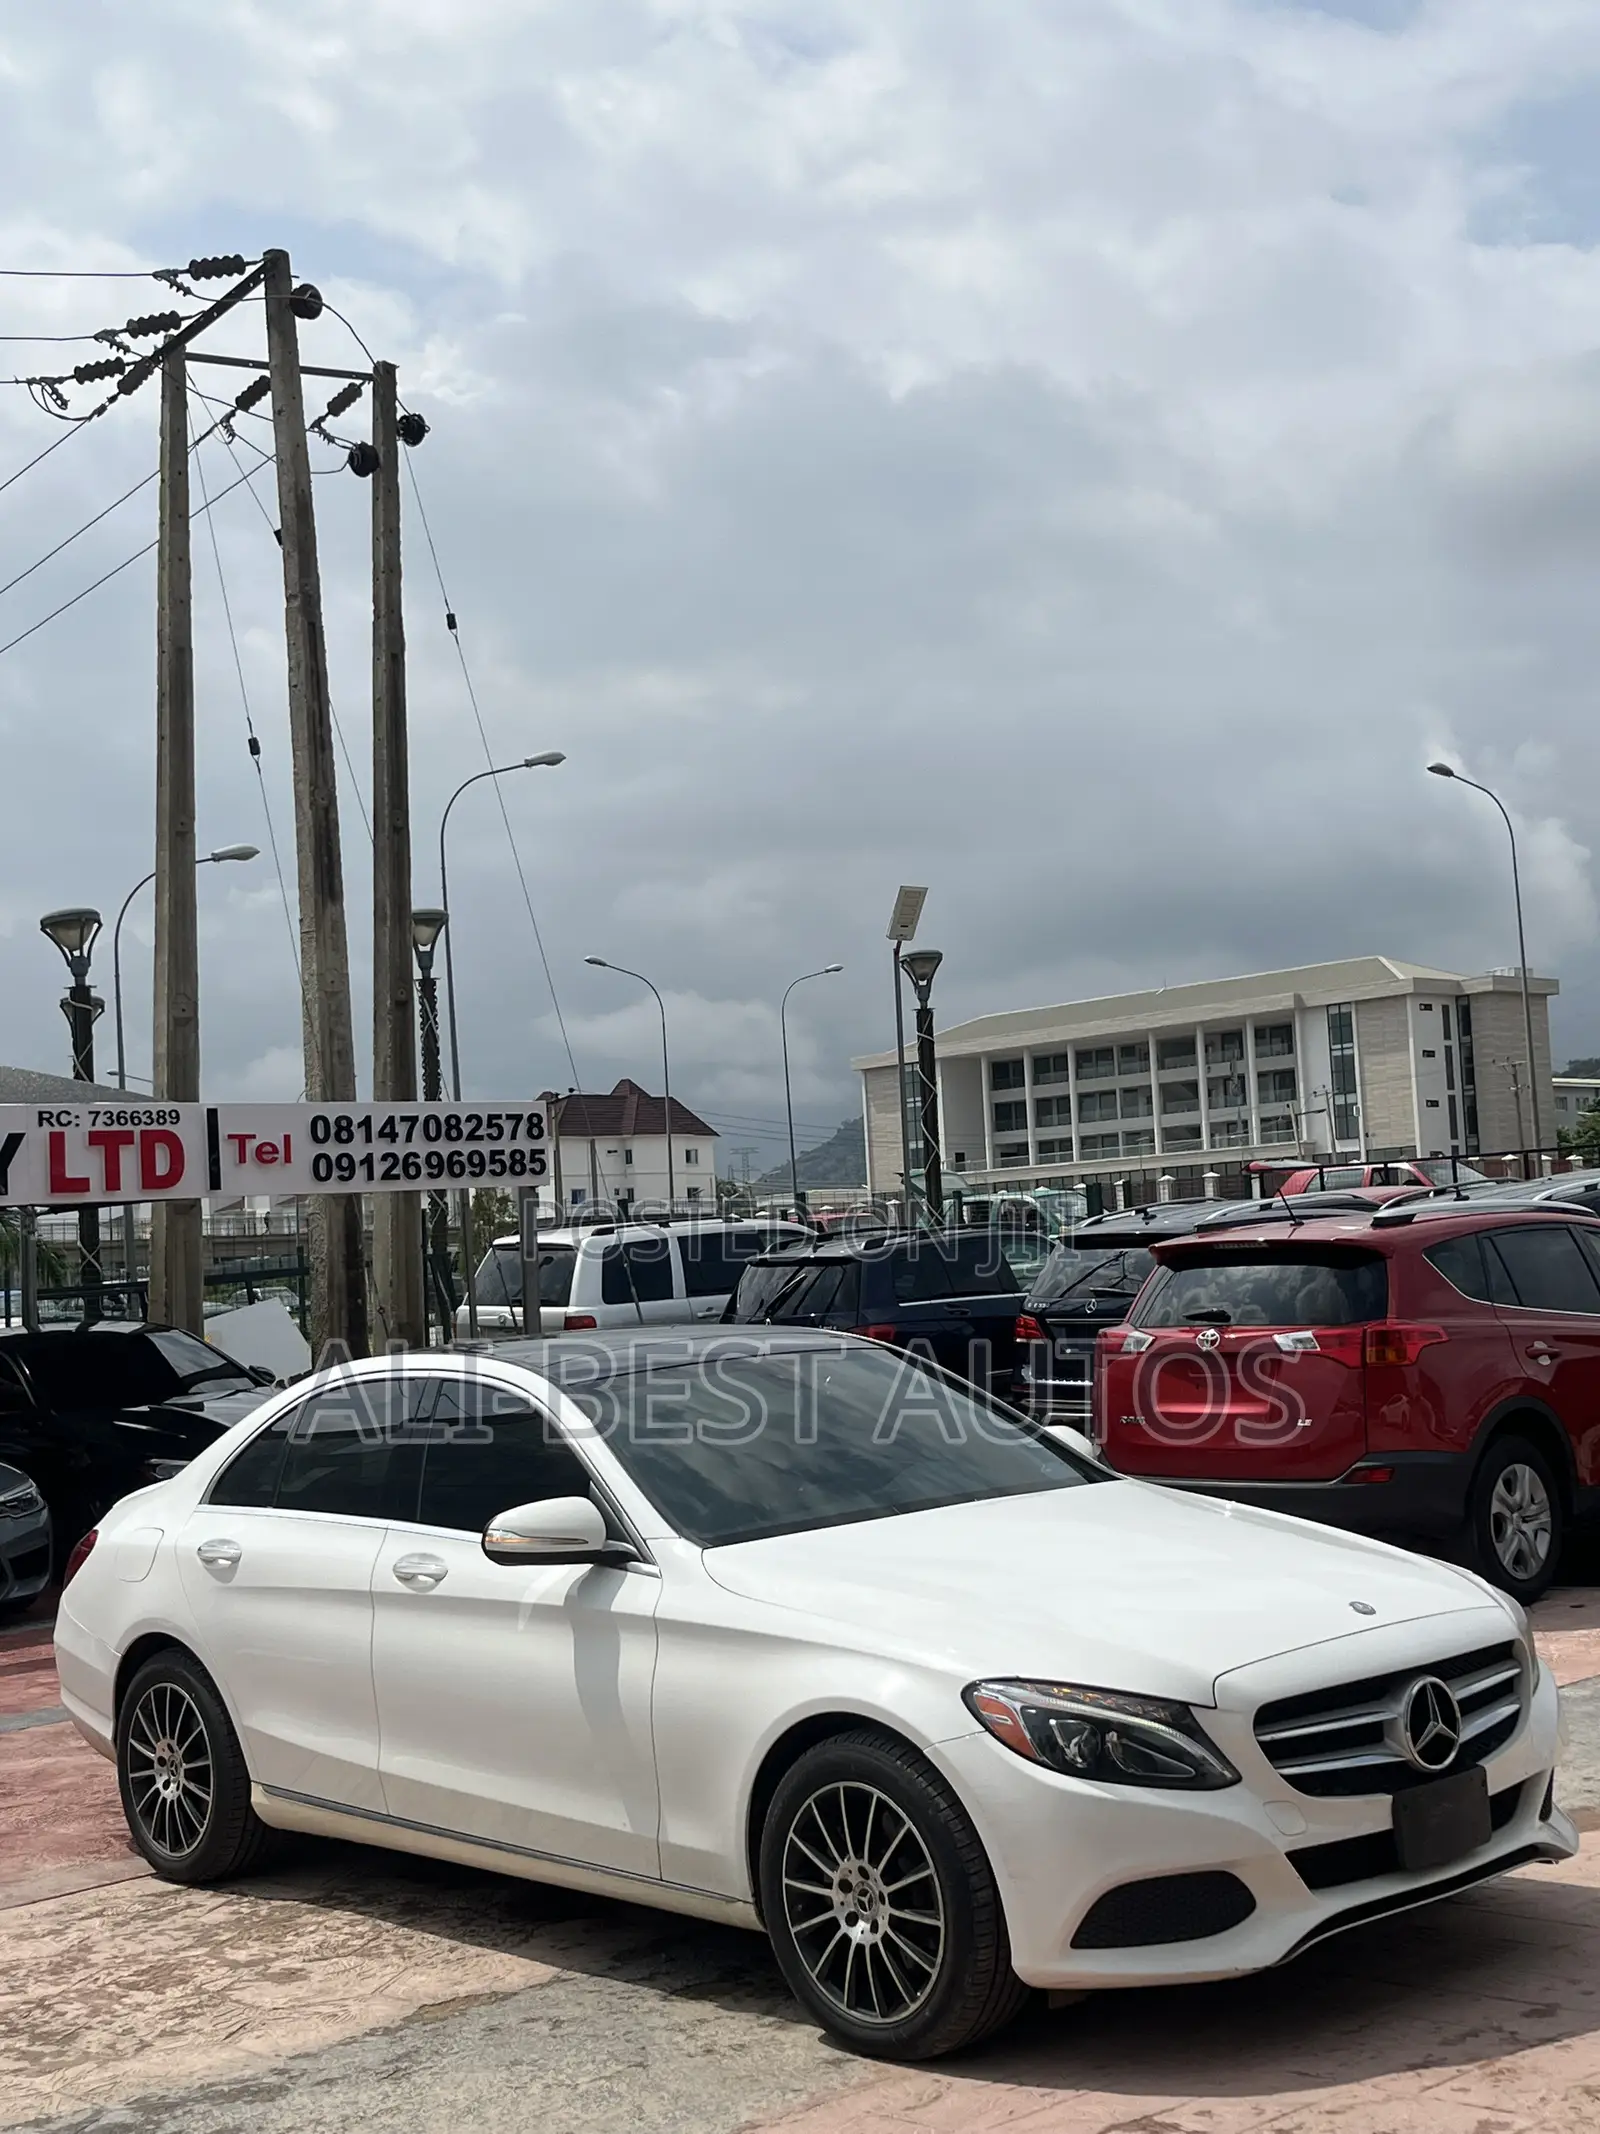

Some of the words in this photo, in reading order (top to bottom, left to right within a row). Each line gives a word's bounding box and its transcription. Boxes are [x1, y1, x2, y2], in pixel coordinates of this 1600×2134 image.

[37, 1110, 81, 1128] RC:
[87, 1109, 181, 1127] 7366389
[310, 1112, 545, 1144] 08147082578
[49, 1129, 185, 1194] LTD
[227, 1134, 292, 1164] Tel
[312, 1149, 547, 1182] 09126969585
